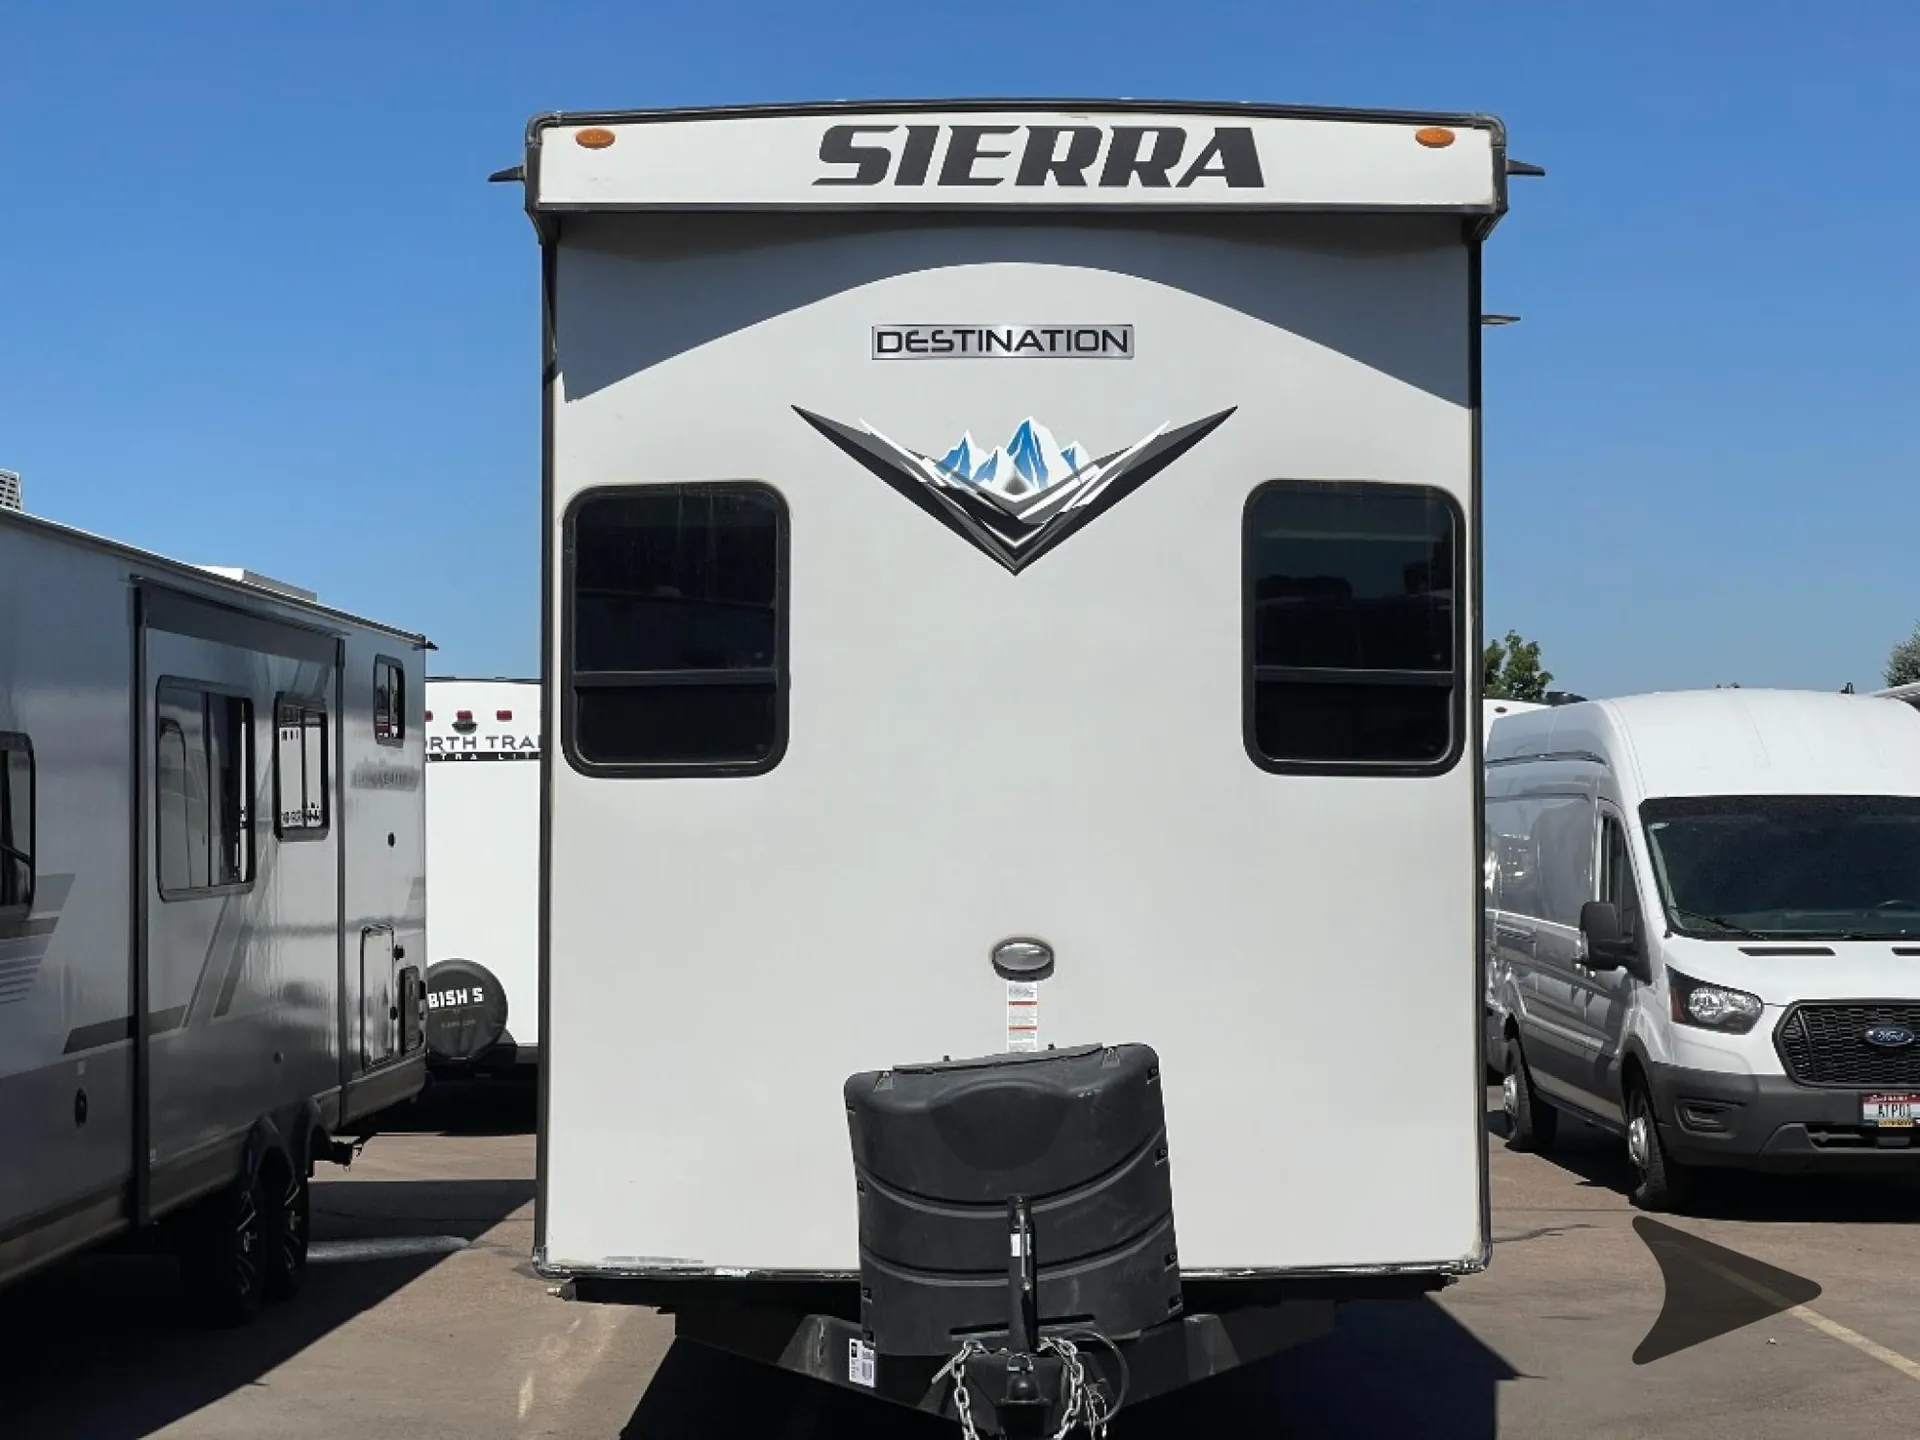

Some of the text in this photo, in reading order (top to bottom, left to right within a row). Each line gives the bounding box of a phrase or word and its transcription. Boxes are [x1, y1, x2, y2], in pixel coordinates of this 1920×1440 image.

[811, 125, 1266, 188] SIERRA
[876, 329, 1128, 354] DESTINATION
[427, 987, 484, 1009] BISHS
